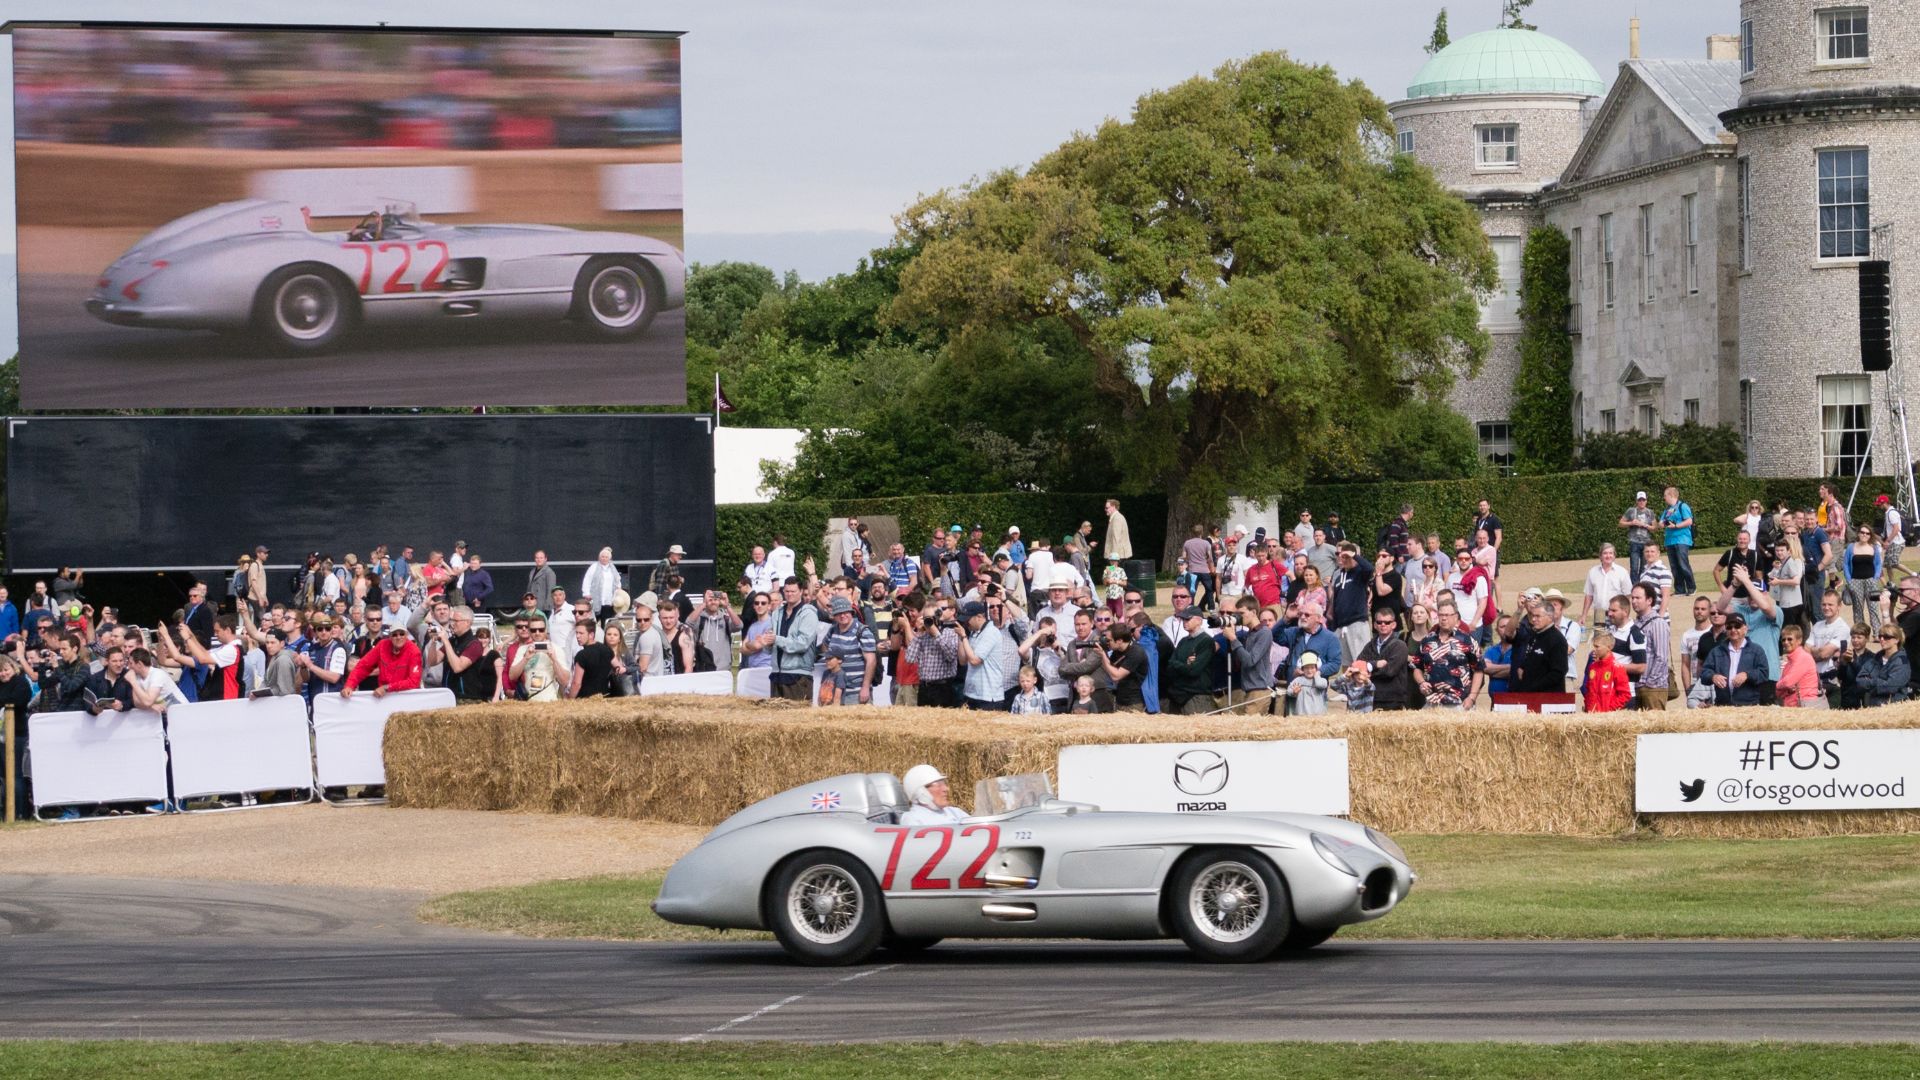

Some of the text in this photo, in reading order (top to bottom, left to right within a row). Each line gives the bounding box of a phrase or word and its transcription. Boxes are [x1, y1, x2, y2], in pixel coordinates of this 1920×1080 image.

[341, 240, 449, 295] 722
[1739, 740, 1841, 771] #FOS
[1717, 776, 1905, 805] @fosgoodwood
[1014, 831, 1033, 840] 722
[874, 824, 1001, 891] 722
